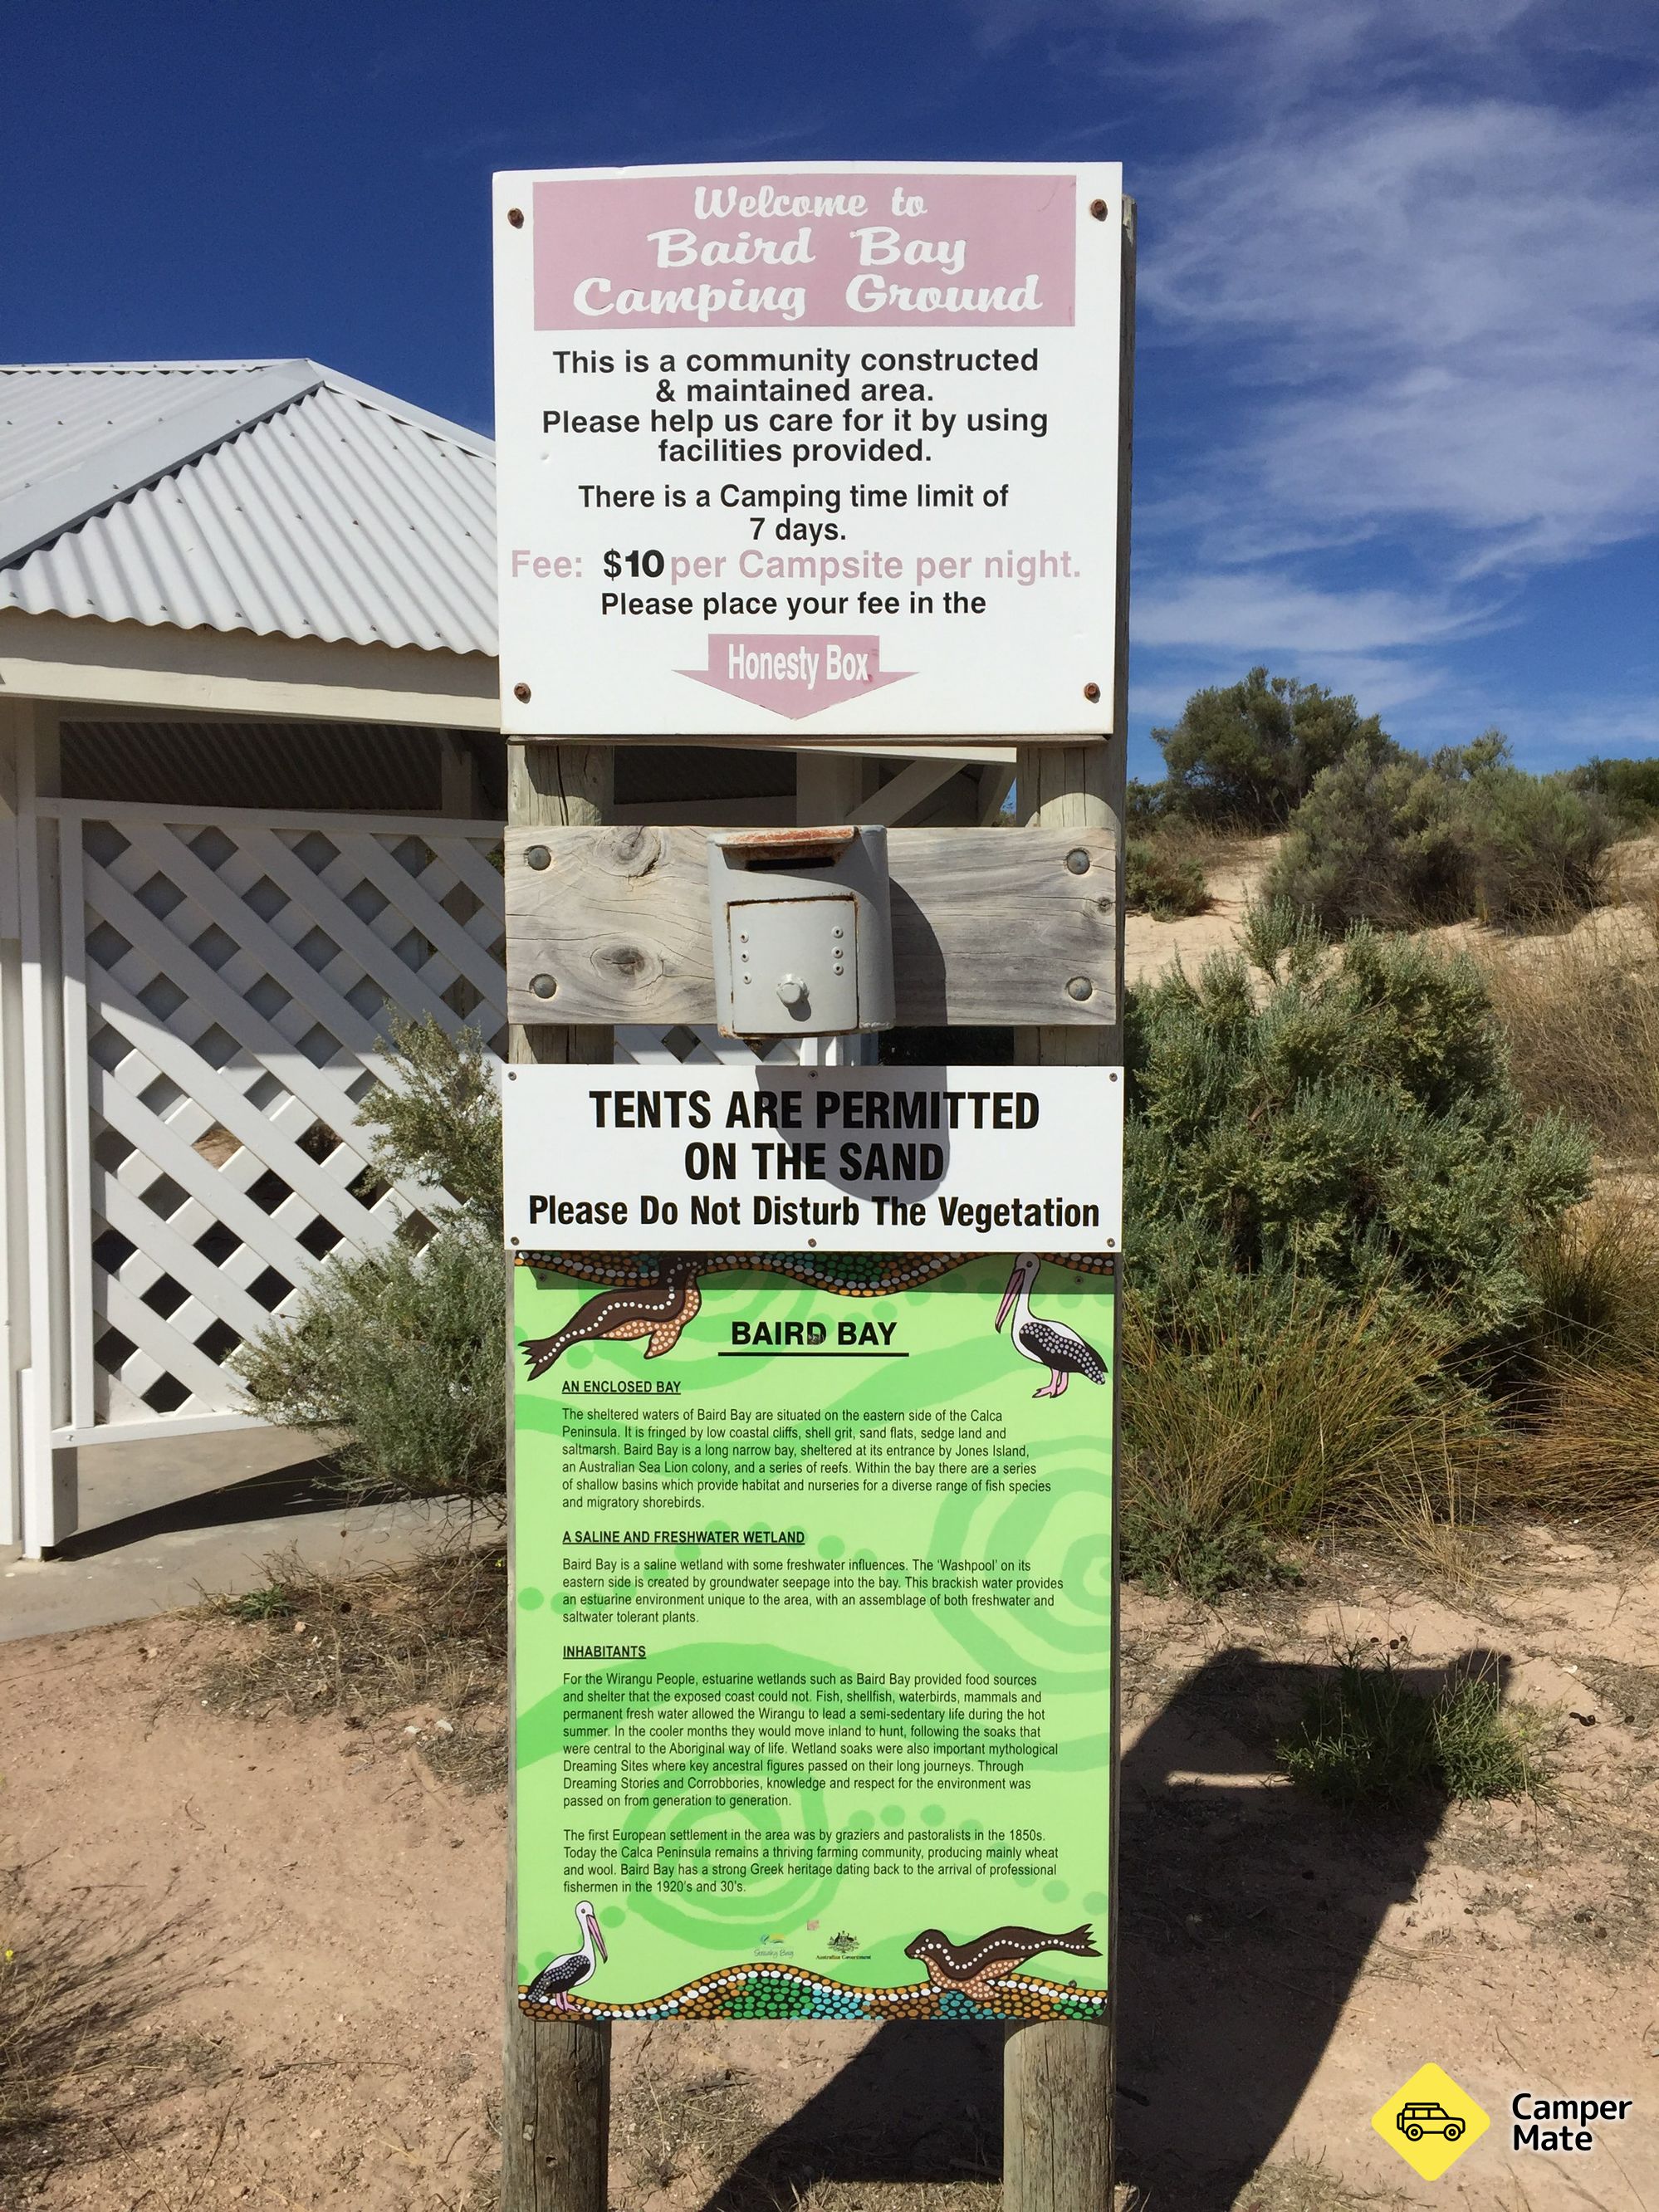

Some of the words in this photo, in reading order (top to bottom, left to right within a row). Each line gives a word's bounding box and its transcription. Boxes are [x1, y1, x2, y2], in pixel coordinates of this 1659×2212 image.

[695, 186, 868, 219] Welcome
[892, 187, 927, 217] to
[647, 228, 815, 267] Baird
[850, 227, 966, 275] Bay
[574, 278, 805, 322] Camping
[846, 275, 1043, 312] Ground
[553, 350, 614, 374] This
[626, 350, 648, 373] is
[660, 355, 676, 372] a
[687, 347, 850, 377] community
[861, 348, 1038, 371] constructed
[656, 379, 676, 403] &
[688, 377, 849, 402] maintained
[861, 384, 933, 402] area.
[543, 410, 639, 433] Please
[651, 409, 713, 437] help
[725, 414, 758, 432] us
[770, 414, 833, 432] care
[842, 408, 883, 432] for
[894, 408, 912, 431] it
[922, 408, 957, 437] by
[967, 408, 1047, 437] using
[658, 437, 781, 462] facilities
[793, 438, 931, 467] provided.
[578, 485, 654, 507] There
[665, 484, 686, 507] is
[696, 490, 711, 507] a
[721, 484, 840, 513] Camping
[849, 484, 908, 507] time
[918, 484, 974, 507] limit
[983, 484, 1009, 507] of
[750, 517, 765, 540] 7
[776, 517, 845, 546] days.
[512, 550, 582, 578] Fee:
[603, 546, 664, 584] $10
[671, 556, 727, 585] per
[739, 550, 903, 585] Campsite
[917, 557, 972, 586] per
[985, 550, 1080, 586] night.
[602, 592, 693, 615] Please
[703, 592, 777, 620] place
[786, 597, 849, 620] your
[857, 591, 899, 614] fee
[910, 591, 932, 614] in
[942, 591, 986, 614] the
[729, 644, 819, 689] Honesty
[827, 645, 868, 680] Box
[590, 1091, 710, 1128] TENTS
[727, 1091, 801, 1128] ARE
[817, 1091, 1039, 1128] PERMITTED
[686, 1143, 735, 1180] ON
[752, 1143, 825, 1179] THE
[839, 1143, 943, 1181] SAND
[531, 1196, 627, 1224] Please
[641, 1196, 677, 1224] Do
[692, 1197, 740, 1225] Not
[755, 1197, 859, 1225] Disturb
[872, 1197, 925, 1226] The
[939, 1197, 1099, 1232] Vegetation
[731, 1321, 827, 1346] BAIRD
[837, 1321, 898, 1346] BAY
[562, 1381, 579, 1392] AN
[584, 1381, 652, 1392] ENCLOSED
[657, 1381, 681, 1392] BAY
[562, 1408, 583, 1420] The
[587, 1408, 639, 1420] sheltered
[643, 1409, 679, 1420] waters
[683, 1408, 694, 1420] of
[697, 1408, 726, 1421] Baird
[731, 1409, 751, 1423] Bay
[756, 1412, 773, 1421] are
[777, 1409, 820, 1421] situated
[825, 1412, 838, 1421] on
[843, 1409, 859, 1421] the
[864, 1410, 904, 1421] eastern
[909, 1410, 932, 1421] side
[936, 1409, 947, 1421] of
[950, 1409, 967, 1422] the
[971, 1409, 1002, 1422] Calca
[563, 1496, 583, 1507] and
[587, 1496, 639, 1510] migratory
[643, 1496, 704, 1508] shorebirds.
[563, 1531, 571, 1541] A
[575, 1531, 620, 1541] SALINE
[624, 1531, 649, 1541] AND
[654, 1531, 739, 1541] FRESHWATER
[743, 1531, 805, 1541] WETLAND
[563, 1559, 591, 1570] Baird
[596, 1559, 617, 1573] Bay
[621, 1559, 629, 1570] is
[634, 1561, 639, 1570] a
[644, 1559, 676, 1570] saline
[680, 1559, 722, 1570] wetland
[727, 1559, 749, 1570] with
[753, 1561, 783, 1570] some
[786, 1559, 845, 1570] freshwater
[849, 1559, 908, 1571] influences.
[913, 1559, 933, 1571] The
[1001, 1562, 1014, 1571] on
[1019, 1559, 1030, 1571] its
[563, 1611, 614, 1622] saltwater
[617, 1611, 658, 1622] tolerant
[663, 1611, 698, 1625] plants.
[564, 1646, 645, 1656] INHABITANTS
[564, 1673, 582, 1685] For
[585, 1673, 602, 1685] the
[606, 1673, 652, 1687] Wirangu
[657, 1673, 697, 1687] People,
[702, 1673, 753, 1684] estuarine
[757, 1673, 806, 1685] wetlands
[810, 1673, 835, 1685] such
[840, 1676, 853, 1685] as
[857, 1673, 885, 1685] Baird
[890, 1673, 910, 1687] Bay
[914, 1673, 962, 1687] provided
[966, 1673, 989, 1685] food
[994, 1676, 1036, 1686] sources
[564, 1794, 603, 1809] passed
[607, 1798, 620, 1806] on
[624, 1794, 648, 1806] from
[653, 1794, 712, 1808] generation
[716, 1795, 726, 1806] to
[730, 1794, 790, 1808] generation.
[564, 1829, 585, 1841] The
[589, 1829, 609, 1841] first
[613, 1829, 666, 1843] European
[670, 1829, 727, 1840] settlement
[732, 1829, 740, 1840] in
[745, 1829, 761, 1840] the
[766, 1832, 790, 1840] area
[794, 1832, 815, 1840] was
[820, 1829, 832, 1843] by
[836, 1828, 879, 1843] graziers
[883, 1829, 903, 1840] and
[908, 1829, 971, 1843] pastoralists
[975, 1829, 983, 1840] in
[988, 1829, 1005, 1841] the
[1010, 1829, 1045, 1841] 1850s.
[564, 1881, 618, 1892] fishermen
[635, 1881, 652, 1892] the
[697, 1881, 717, 1891] and
[721, 1880, 745, 1891] 30's.
